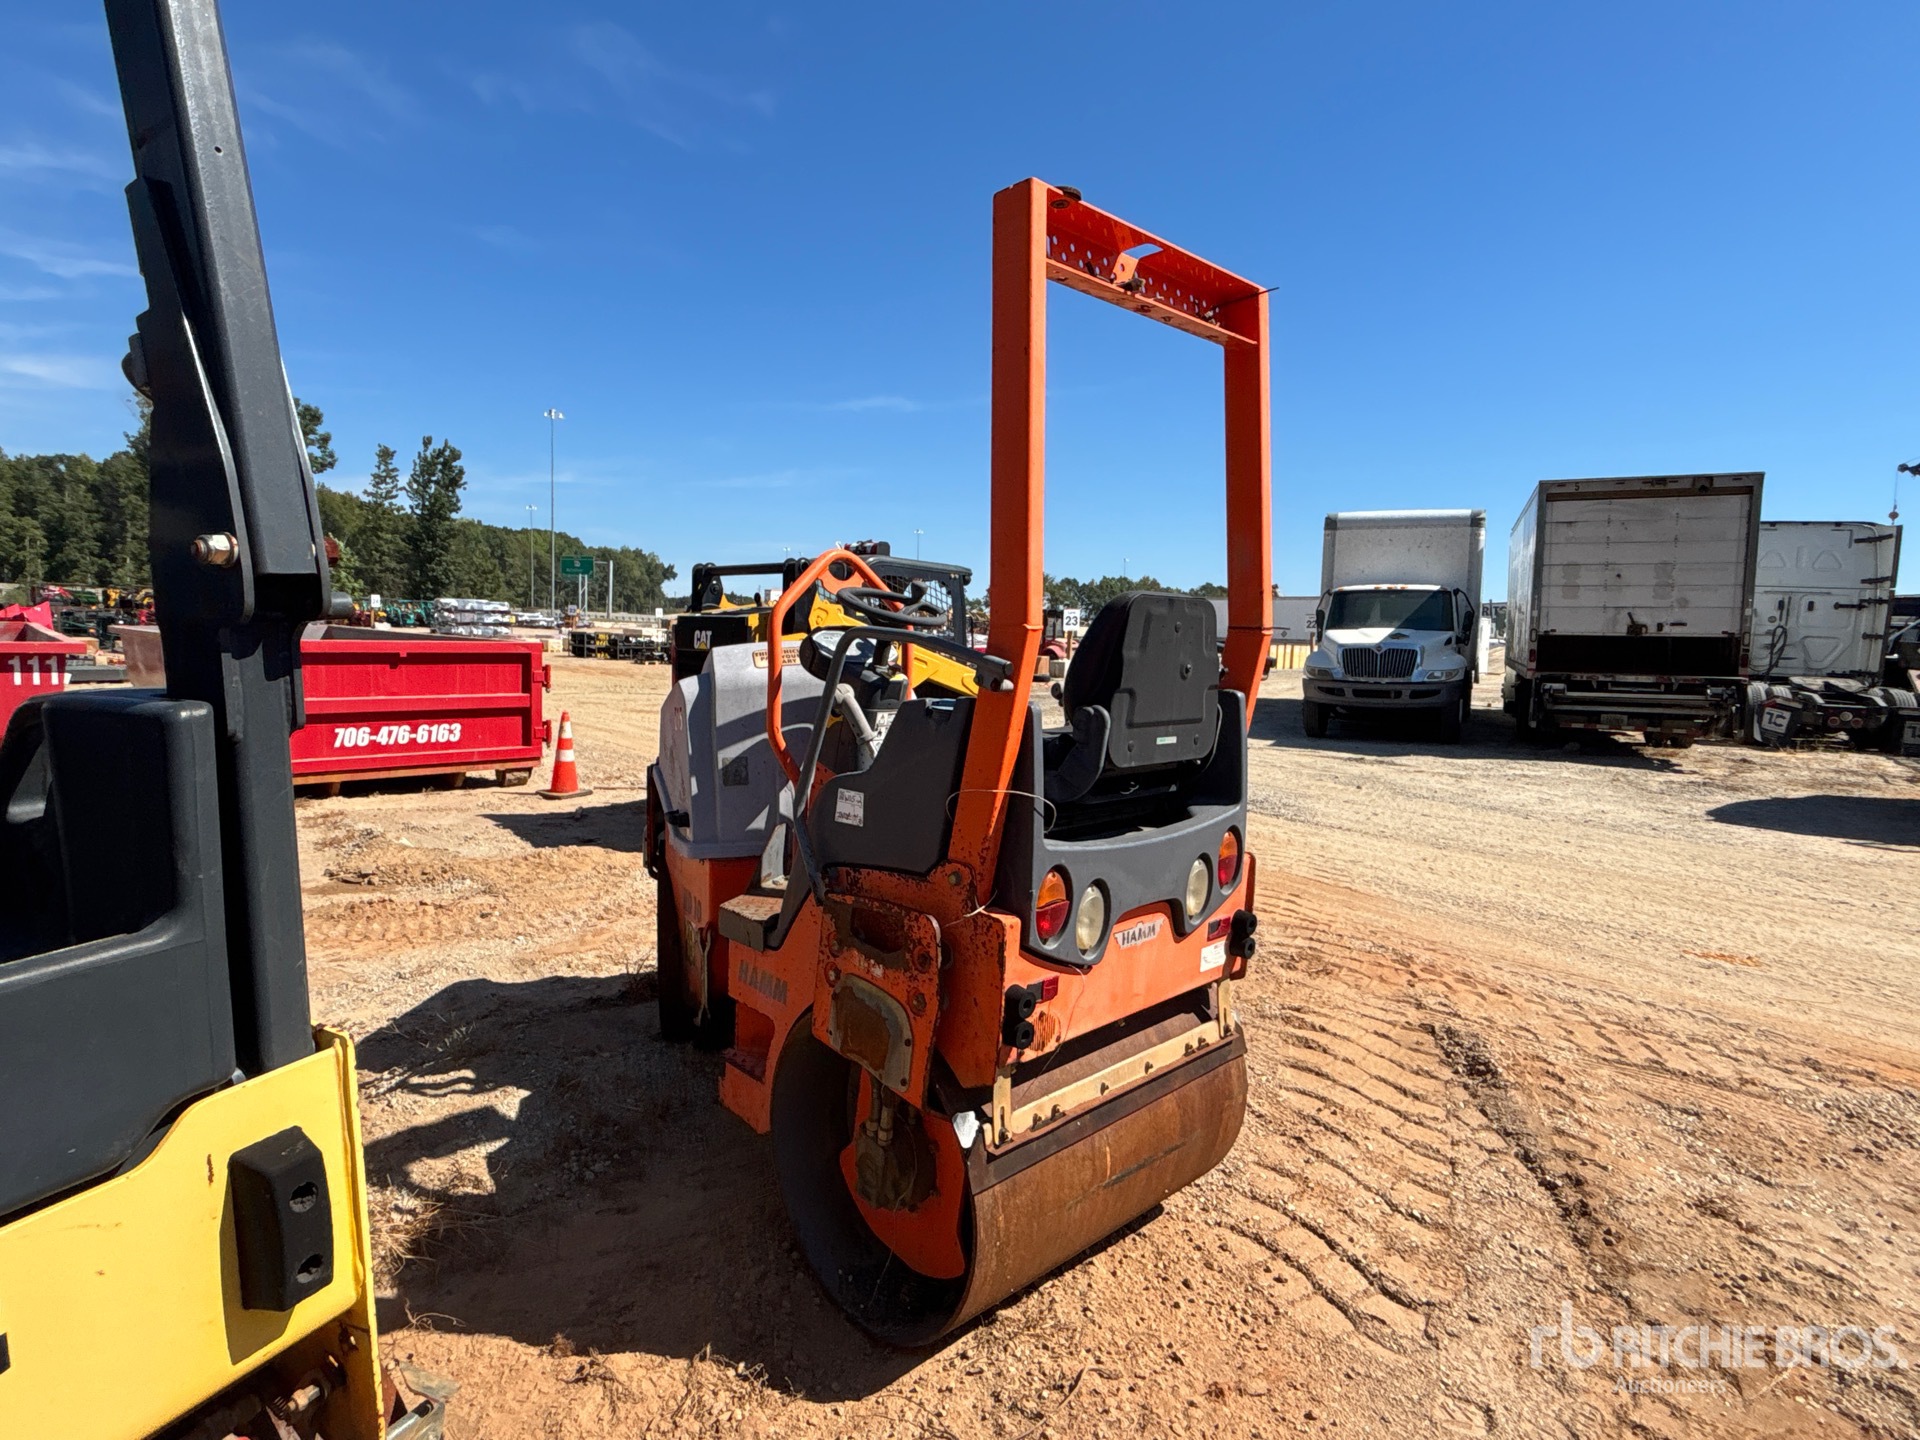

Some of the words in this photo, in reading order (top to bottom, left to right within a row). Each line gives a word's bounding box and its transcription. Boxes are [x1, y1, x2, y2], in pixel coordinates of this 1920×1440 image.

[1065, 616, 1078, 626] 23
[1306, 620, 1317, 628] 22
[694, 630, 712, 649] CAT
[8, 655, 59, 686] 111
[333, 722, 462, 748] 706-476-6163
[1121, 923, 1157, 946] HAMM
